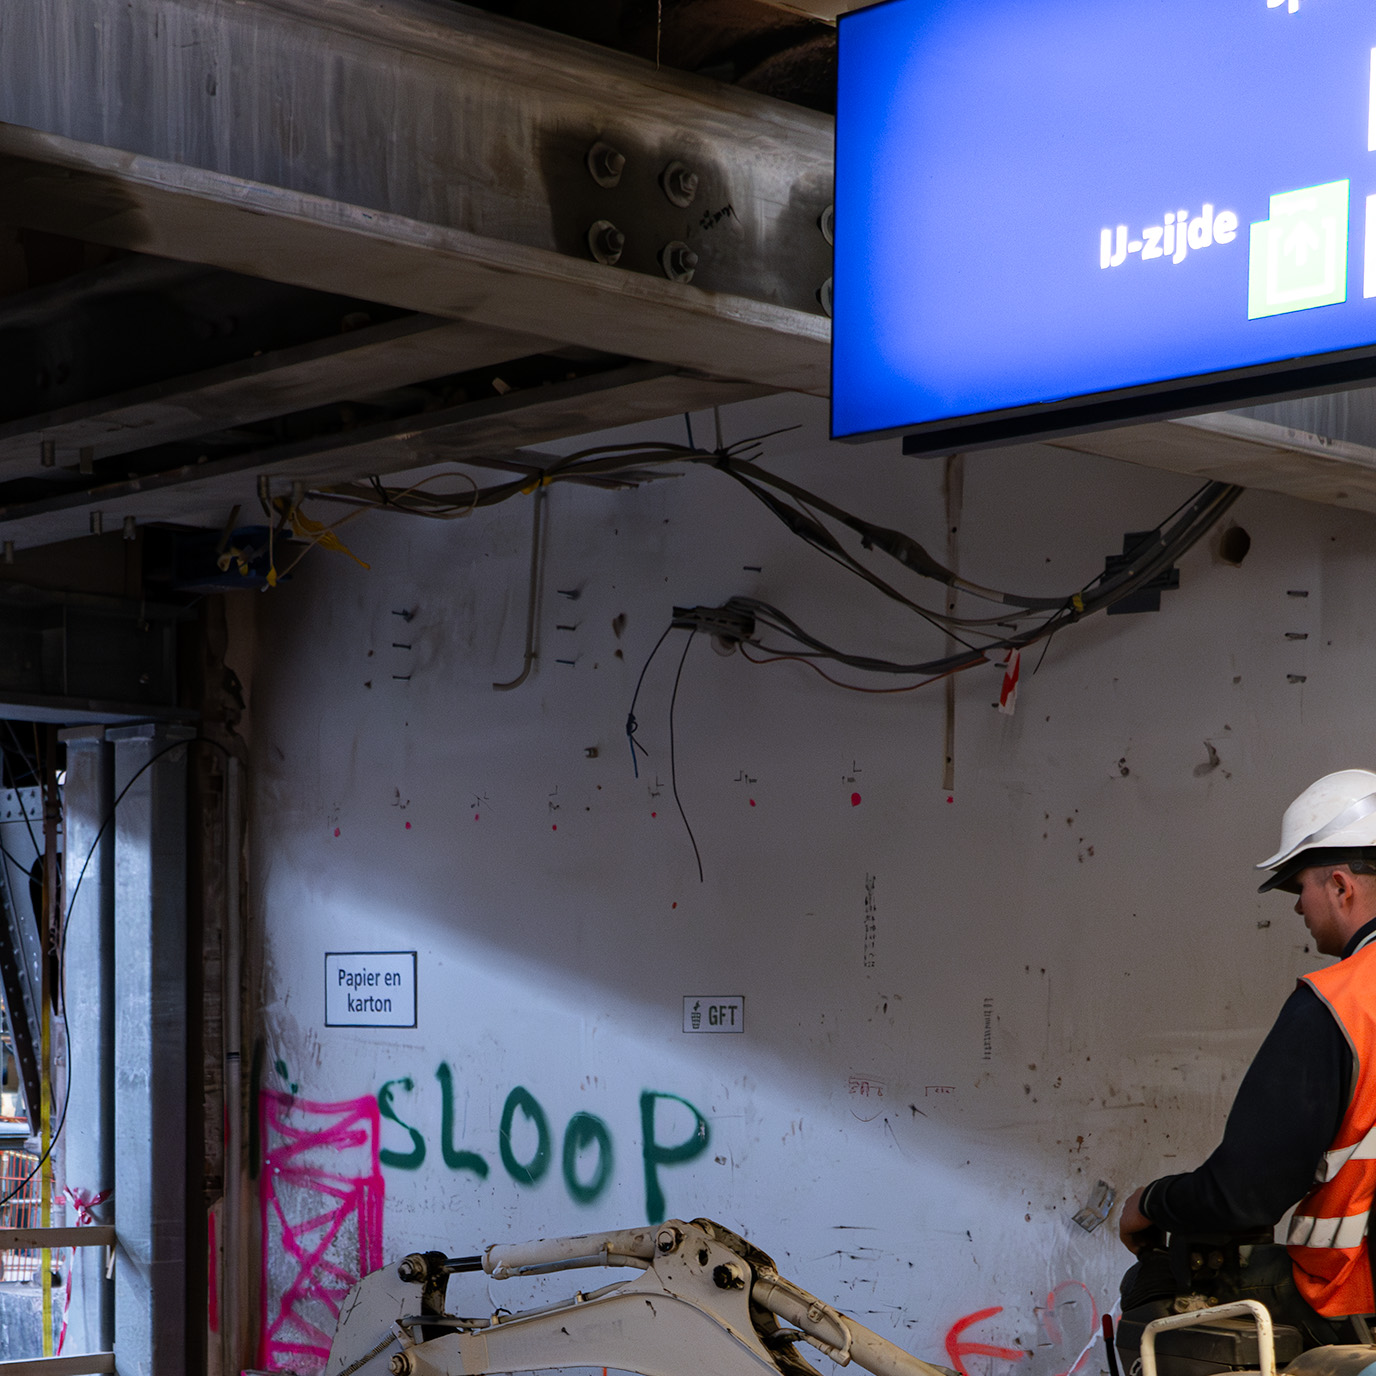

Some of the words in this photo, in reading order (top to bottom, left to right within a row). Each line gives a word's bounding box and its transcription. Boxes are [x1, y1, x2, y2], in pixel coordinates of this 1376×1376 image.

[1100, 203, 1238, 269] IJ-zijde
[338, 967, 381, 991] Papier
[384, 972, 401, 986] en
[347, 993, 392, 1012] karton
[708, 1005, 738, 1026] GFT
[379, 1061, 712, 1224] SLOOP
